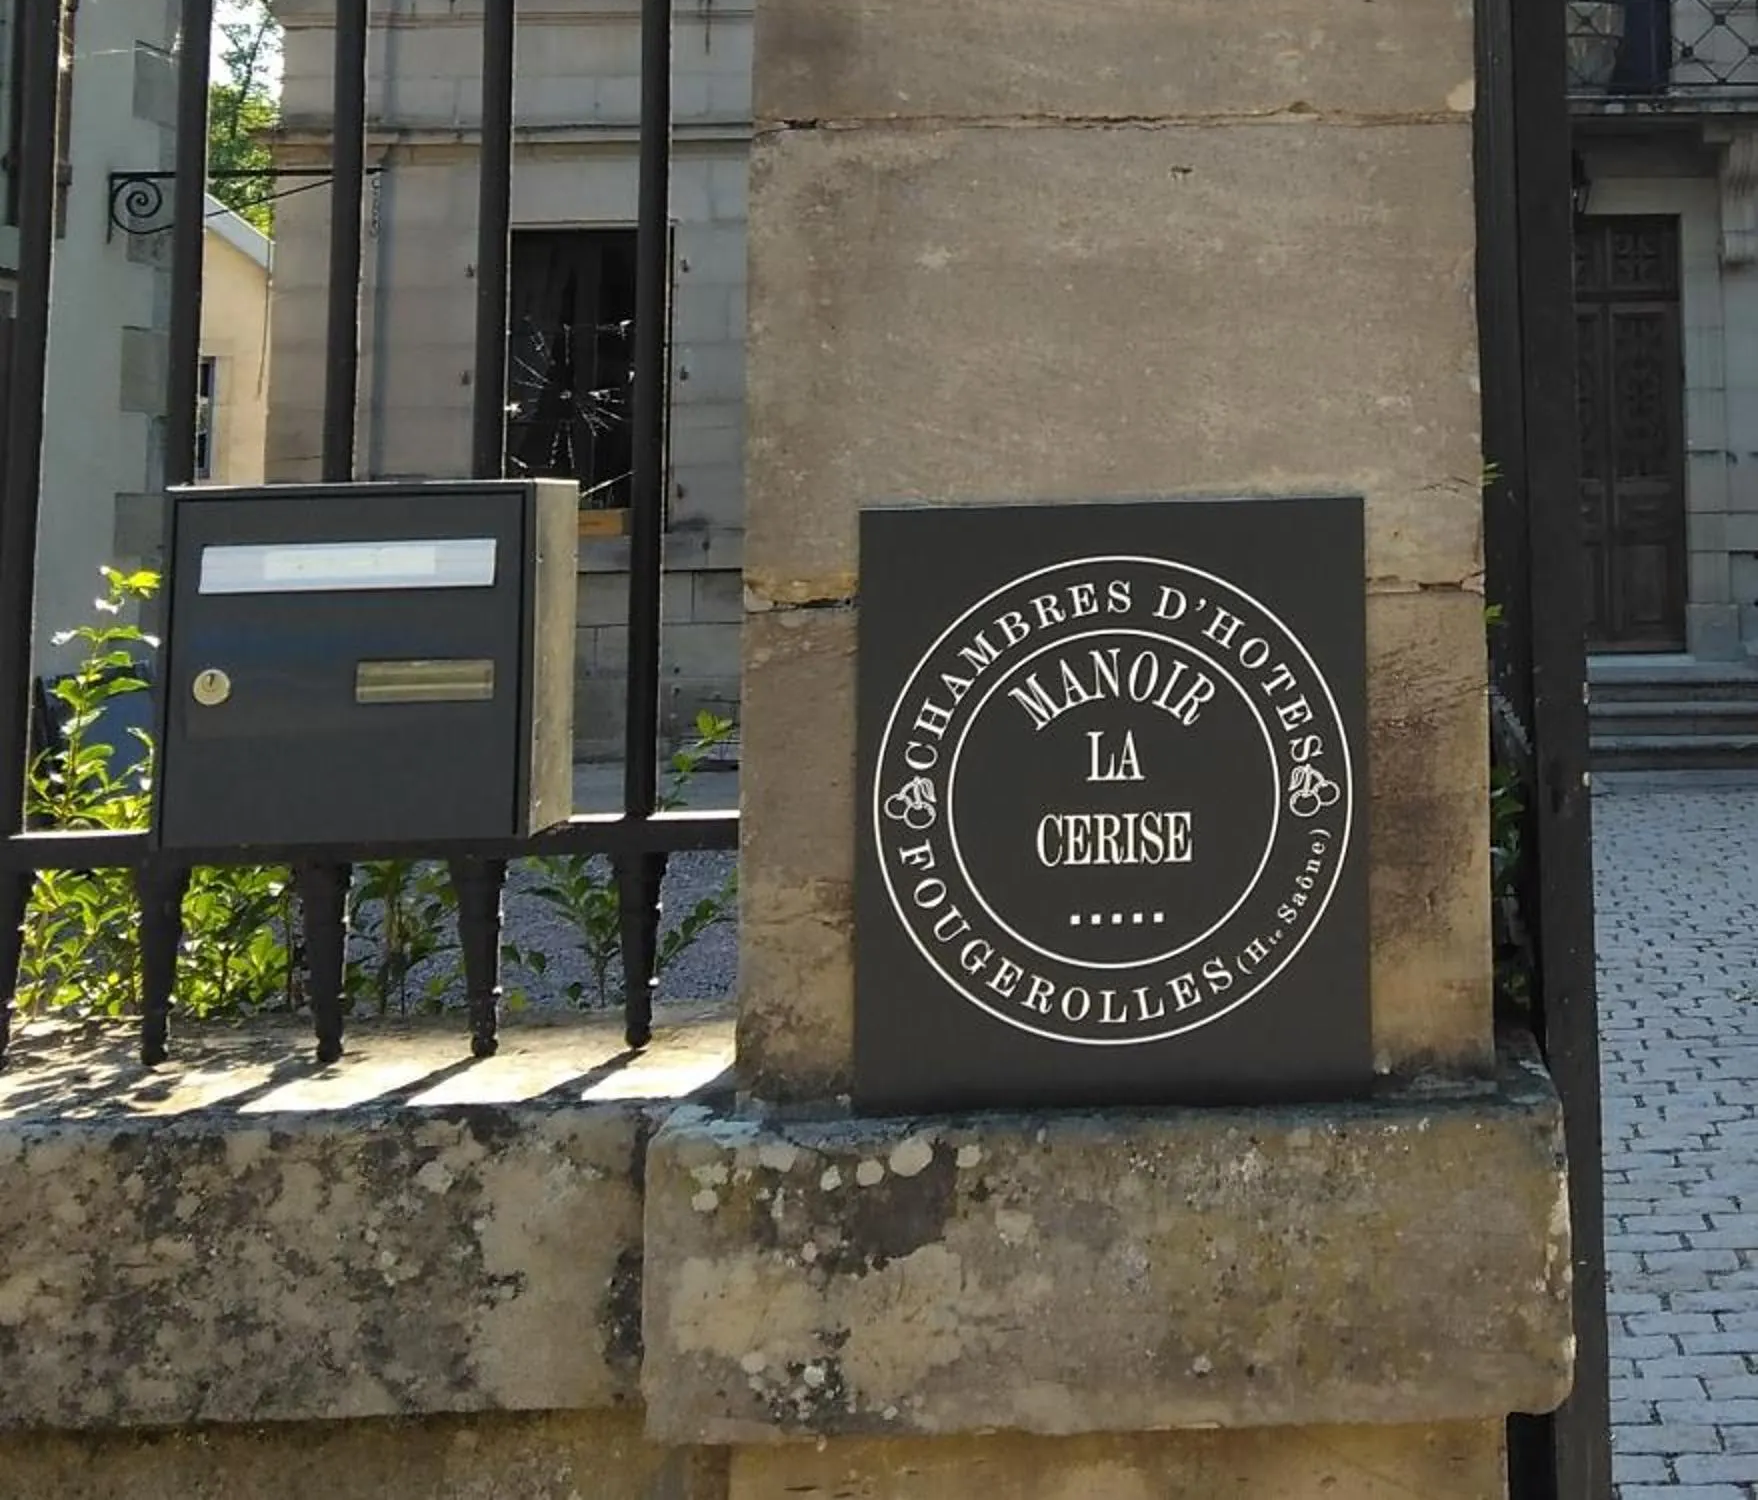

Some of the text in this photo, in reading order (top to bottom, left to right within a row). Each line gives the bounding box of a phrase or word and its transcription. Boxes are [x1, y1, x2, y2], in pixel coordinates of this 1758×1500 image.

[904, 579, 1324, 771] CHAMBRES D'HOTES
[1007, 647, 1216, 731] MANOIR
[1086, 729, 1145, 782] LA
[1036, 811, 1193, 867] CERISE
[898, 838, 1234, 1023] FOUGEROLLES
